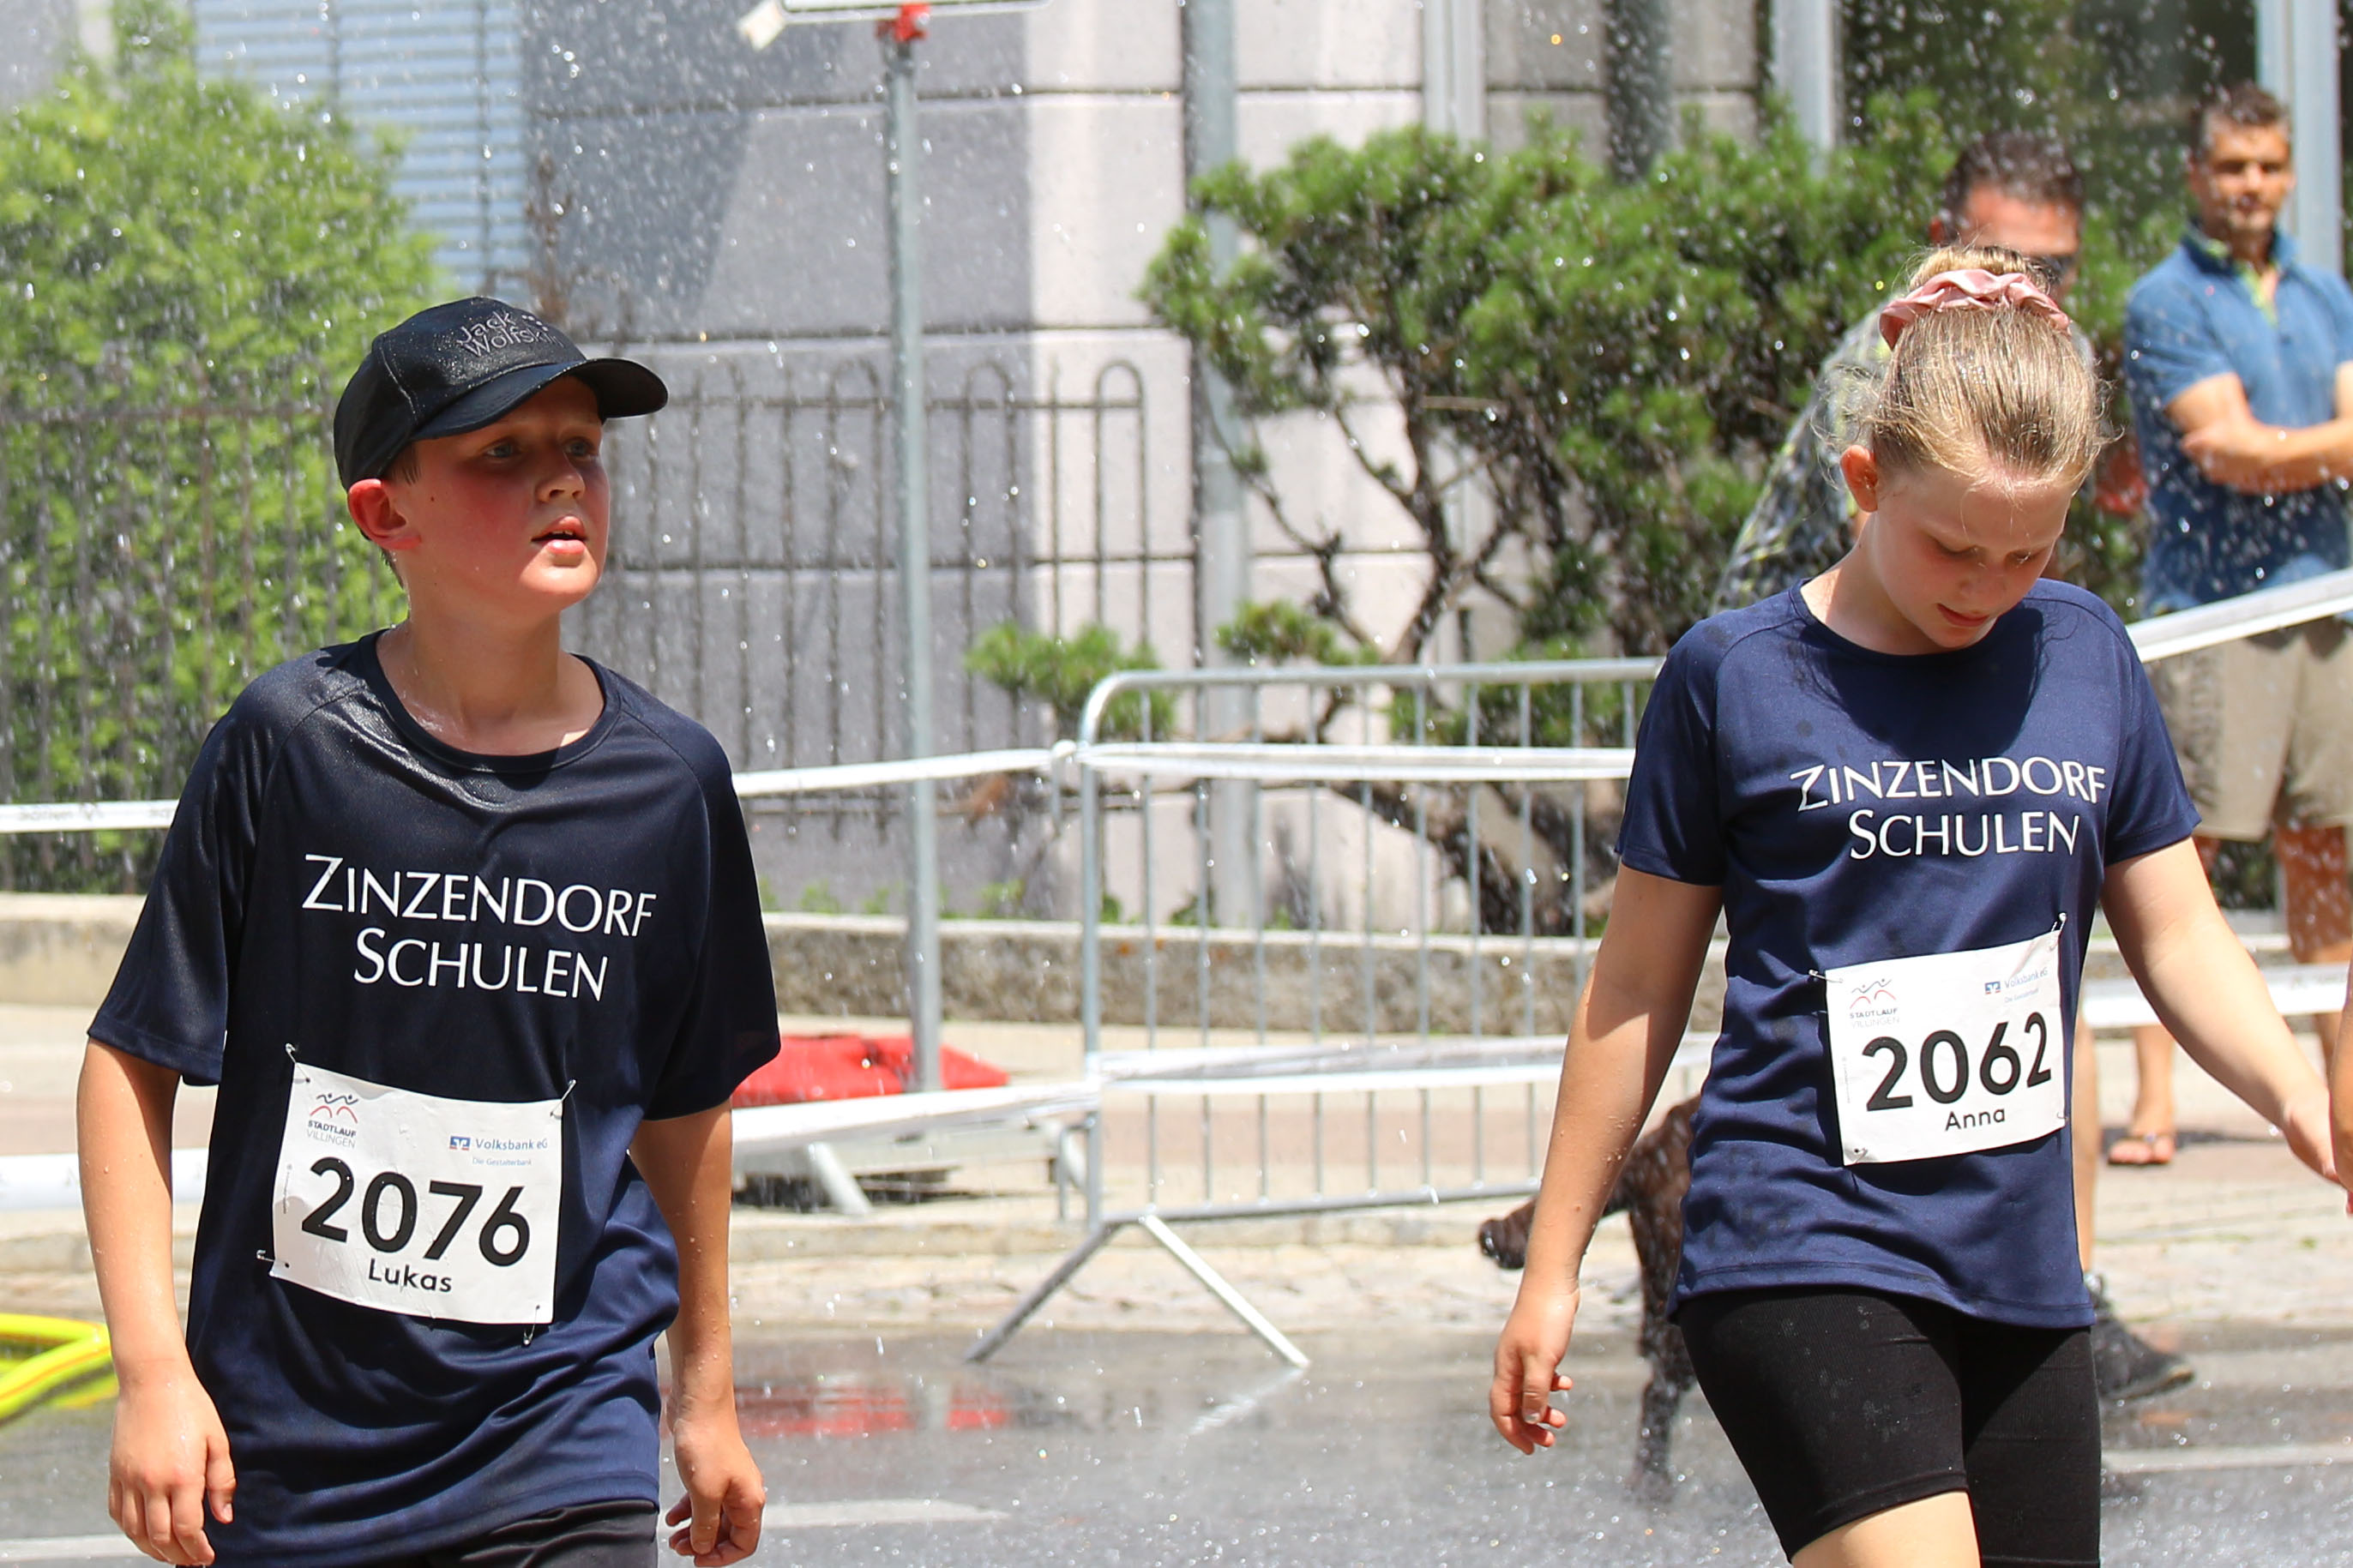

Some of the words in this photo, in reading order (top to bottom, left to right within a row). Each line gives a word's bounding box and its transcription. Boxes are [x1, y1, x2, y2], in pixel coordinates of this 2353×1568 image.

[457, 310, 516, 345] Jack
[1790, 756, 2106, 811] ZINZENDORF
[1848, 808, 2079, 860] SCHULEN
[302, 854, 657, 936] ZINZENDORF
[353, 928, 608, 1001] SCHULEN
[1850, 1007, 1898, 1018] STADTLAUF
[1862, 1012, 2051, 1112] 2062
[308, 1120, 357, 1138] STADTLAUF
[1945, 1108, 2006, 1132] Anna
[306, 1129, 356, 1149] VILLINGEN
[475, 1138, 534, 1150] Volksbank
[536, 1138, 548, 1149] eG
[302, 1156, 530, 1267] 2076
[368, 1259, 453, 1292] Lukas
